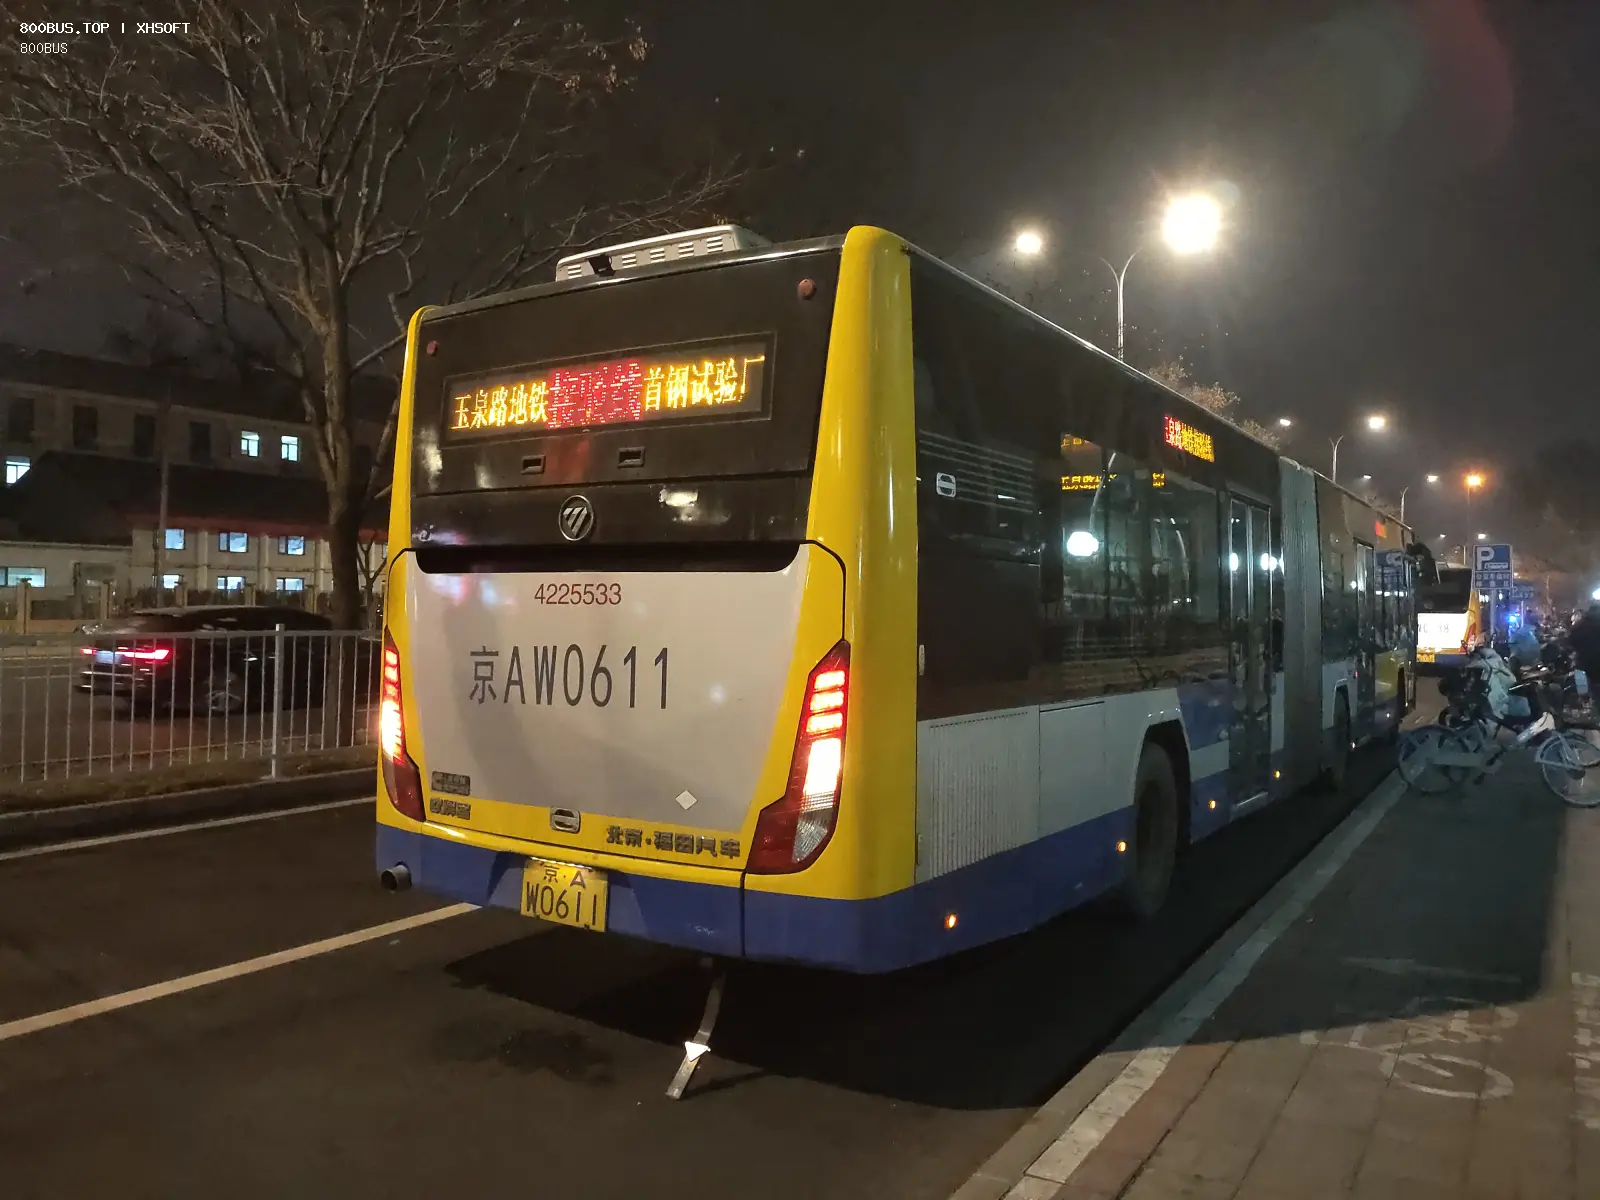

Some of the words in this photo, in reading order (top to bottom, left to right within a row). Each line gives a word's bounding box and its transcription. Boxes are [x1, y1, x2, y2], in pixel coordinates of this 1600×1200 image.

[451, 381, 548, 430] 玉泉路地铁
[1476, 546, 1495, 571] P
[534, 583, 622, 605] 4225533
[469, 643, 668, 710] 京AW0611
[526, 881, 598, 926] W0611
